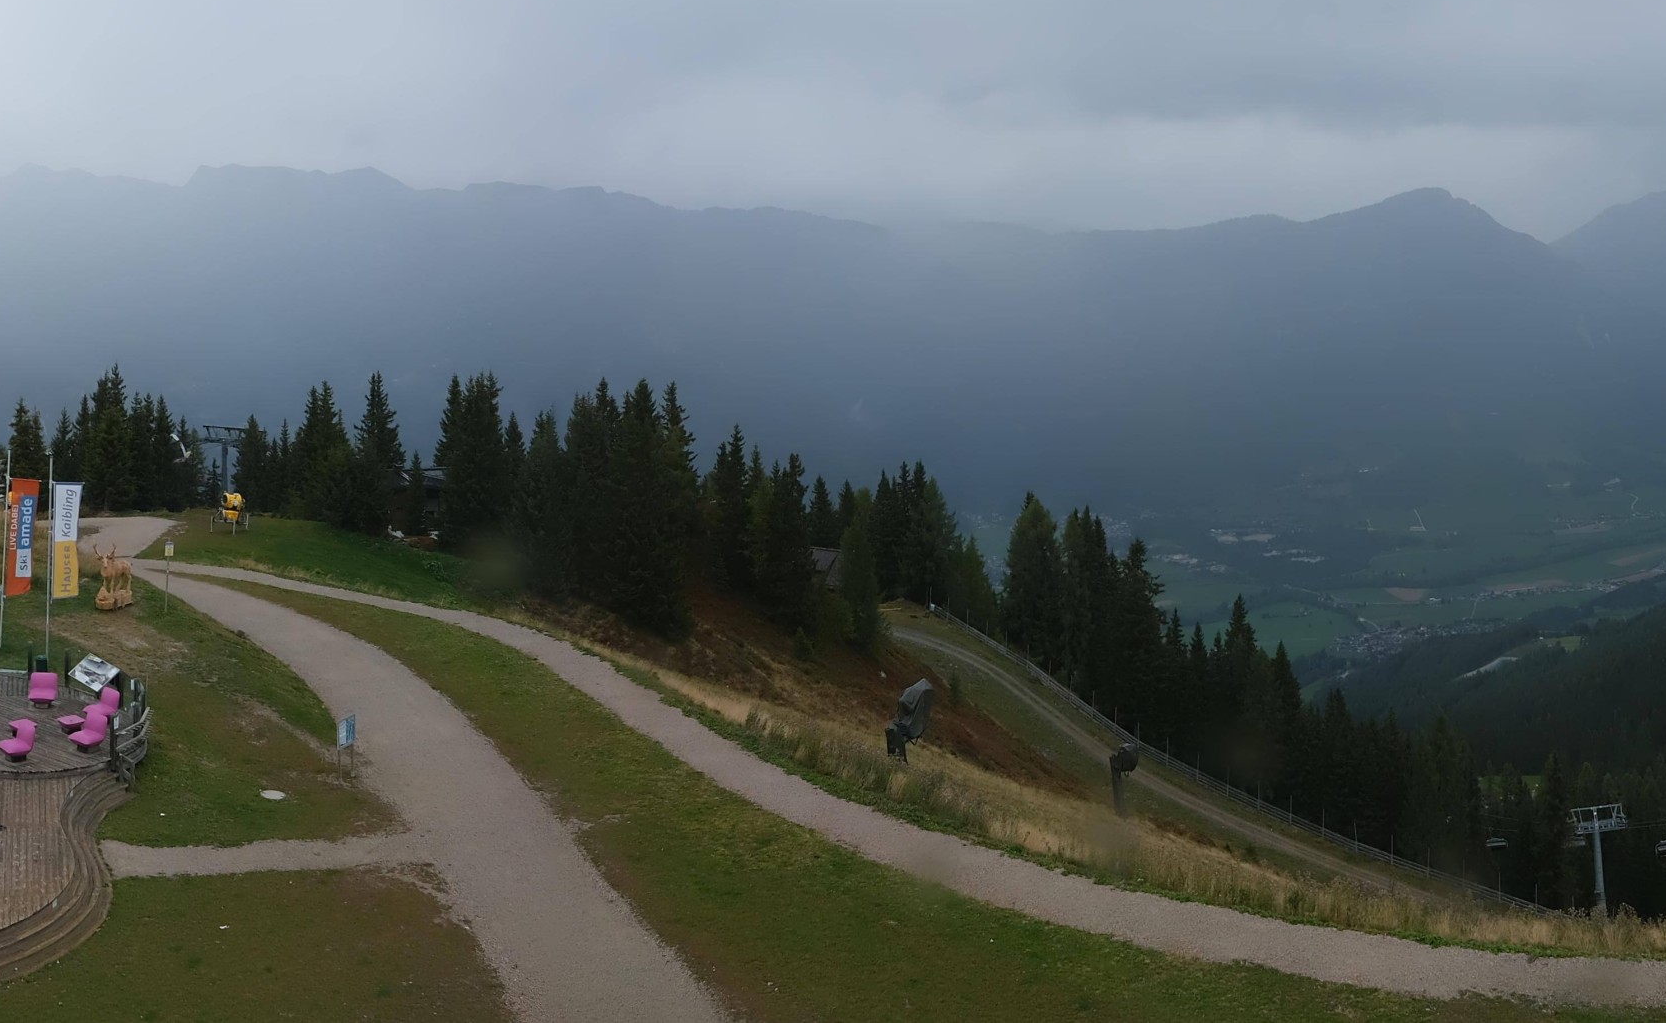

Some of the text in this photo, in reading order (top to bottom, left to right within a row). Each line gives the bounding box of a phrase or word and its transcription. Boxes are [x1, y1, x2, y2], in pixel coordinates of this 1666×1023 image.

[9, 504, 19, 551] LIVE DABEI
[20, 498, 33, 571] Ski amade
[60, 488, 77, 593] HAUSER Kaibling
